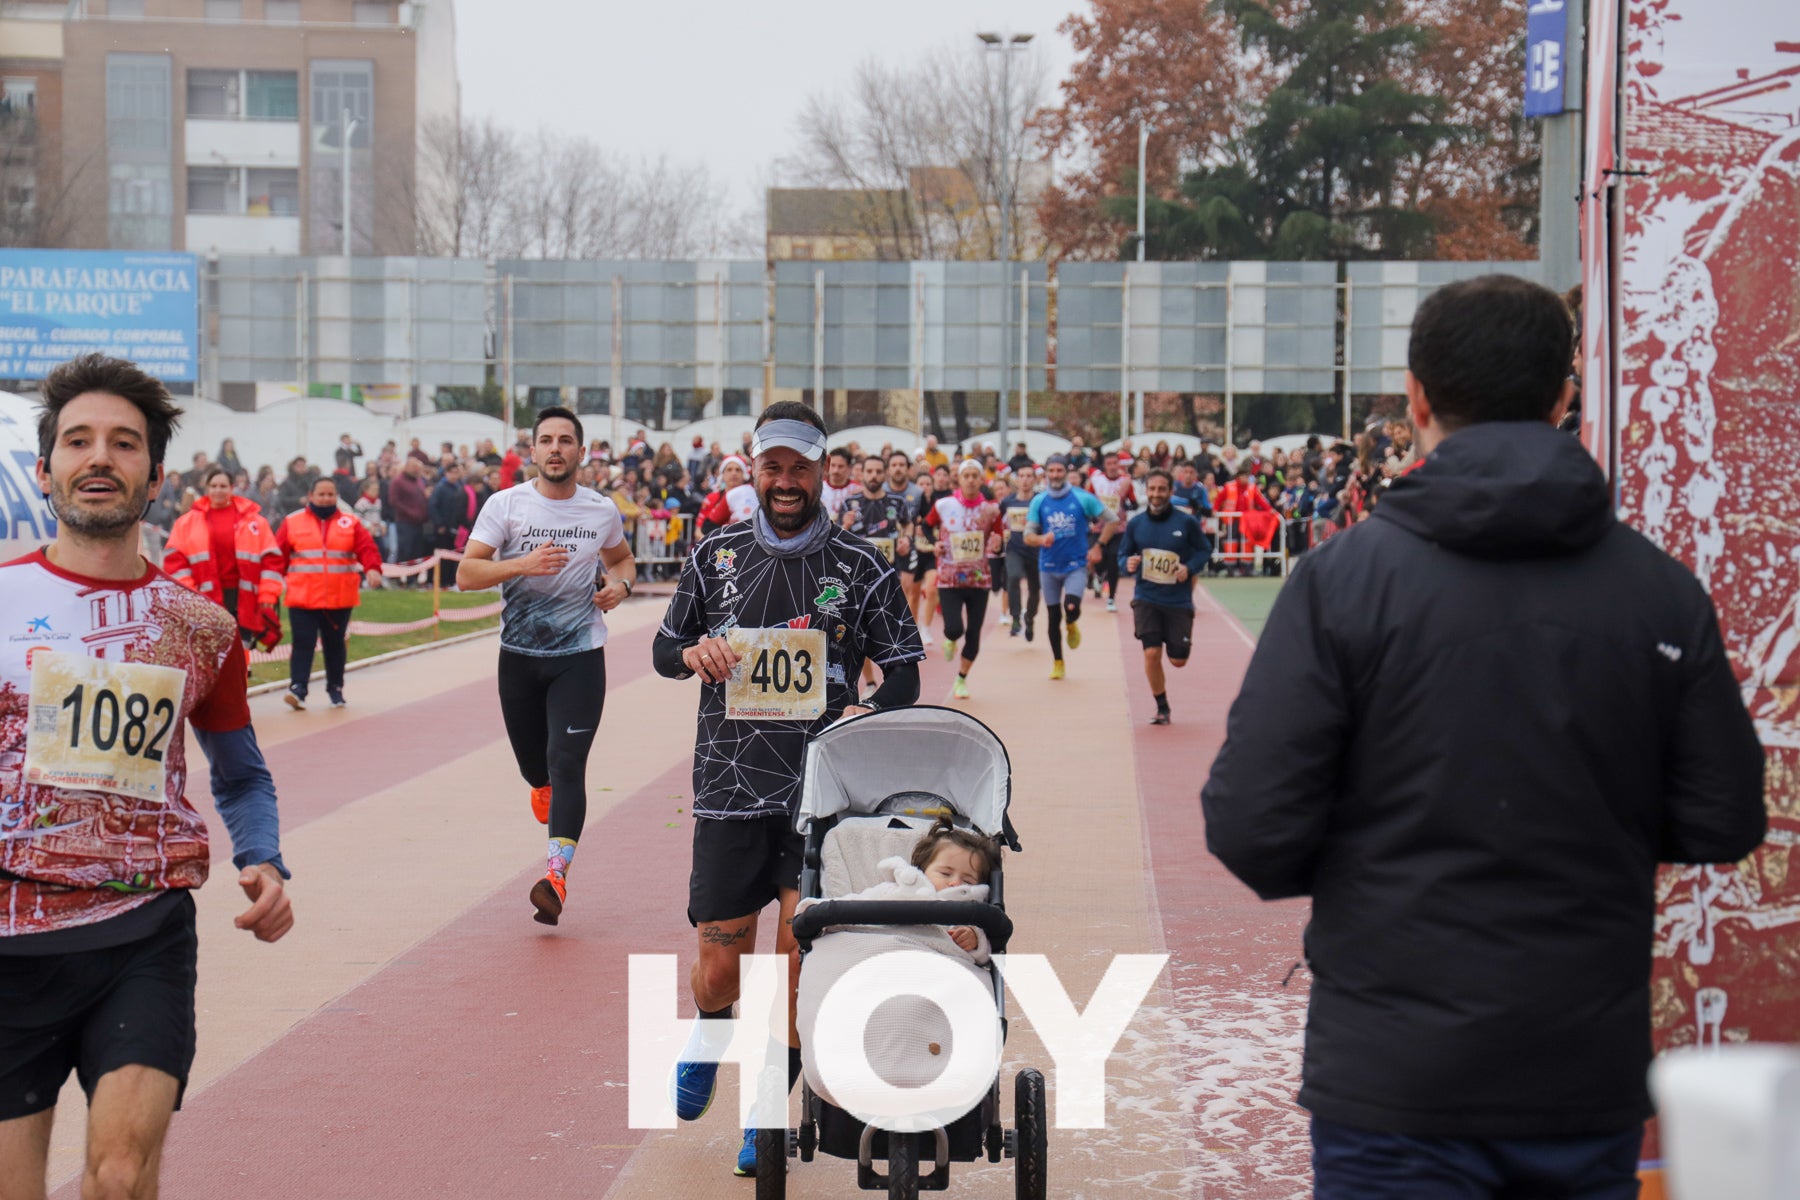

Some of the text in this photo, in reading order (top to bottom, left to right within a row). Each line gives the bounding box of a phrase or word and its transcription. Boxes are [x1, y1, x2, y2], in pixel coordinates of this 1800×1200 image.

[1, 266, 190, 292] PARAFARMACIA
[45, 292, 153, 318] PARQUE"
[50, 327, 110, 342] CUIDADO
[113, 329, 184, 344] CORPORAL
[131, 345, 190, 360] INFANTIL
[522, 525, 598, 541] Jacqueline
[751, 649, 813, 694] 403
[62, 683, 175, 763] 1082
